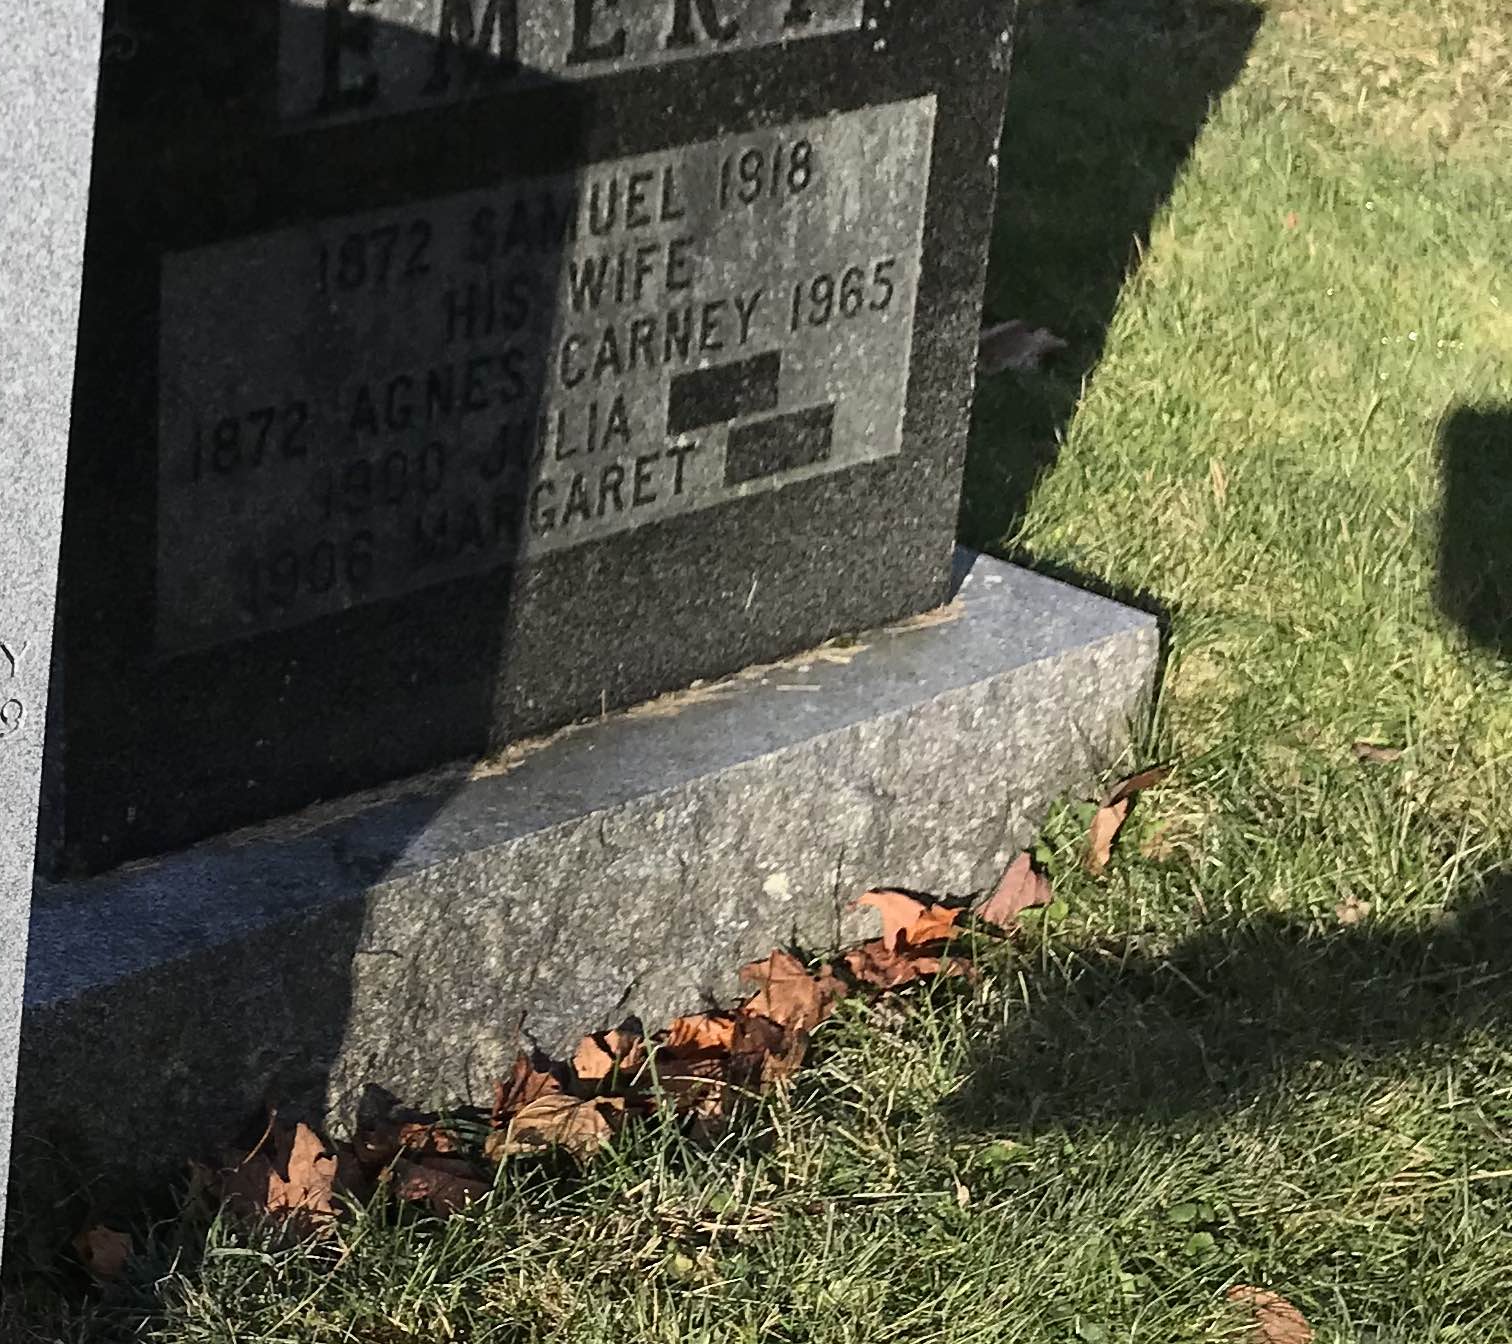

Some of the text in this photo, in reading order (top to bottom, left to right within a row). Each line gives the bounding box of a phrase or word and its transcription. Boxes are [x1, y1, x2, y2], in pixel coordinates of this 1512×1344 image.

[318, 140, 813, 295] 1872 SAMUEL 1918
[443, 236, 694, 346] HIS WIFE
[191, 258, 896, 482] 1872 AGNES CARNEY 1965
[481, 396, 631, 480] JULIA
[413, 442, 697, 559] MARGARET
